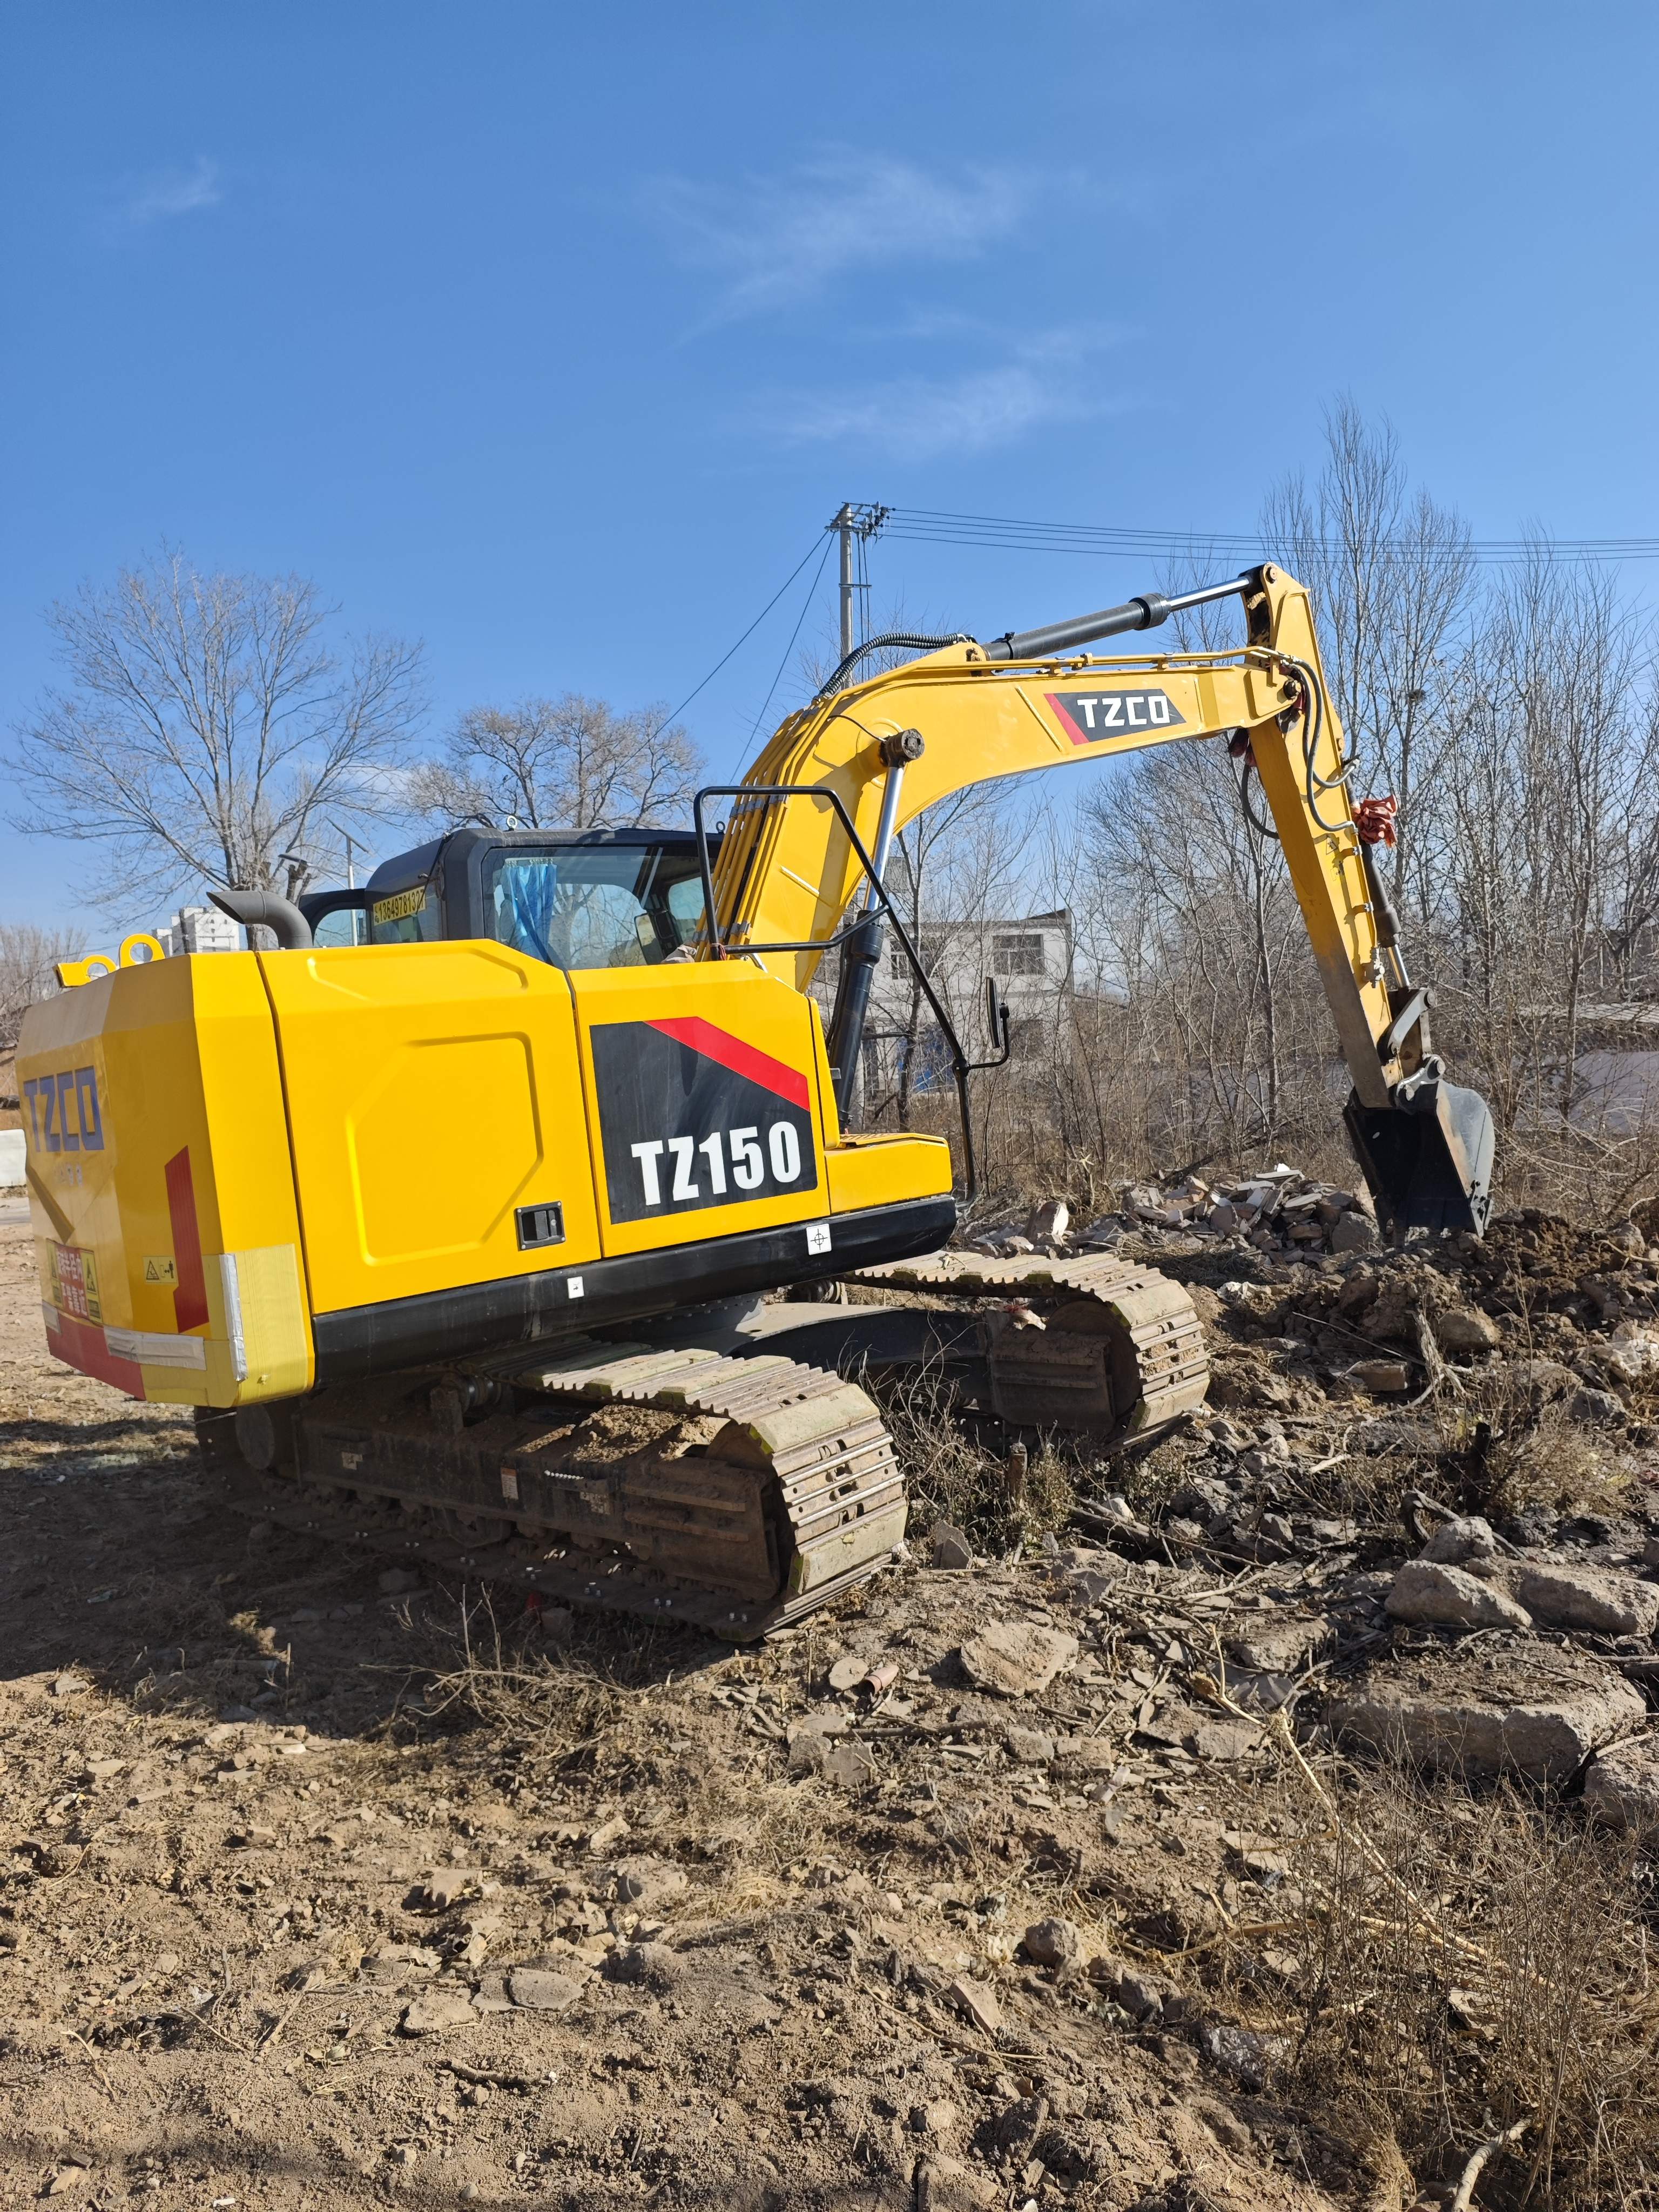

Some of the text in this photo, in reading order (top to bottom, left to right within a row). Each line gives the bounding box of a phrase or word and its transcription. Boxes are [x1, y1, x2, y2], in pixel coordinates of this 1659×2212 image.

[1077, 695, 1170, 728] TZCO
[23, 1065, 104, 1152] TZCO
[631, 1121, 801, 1205] TZ150
